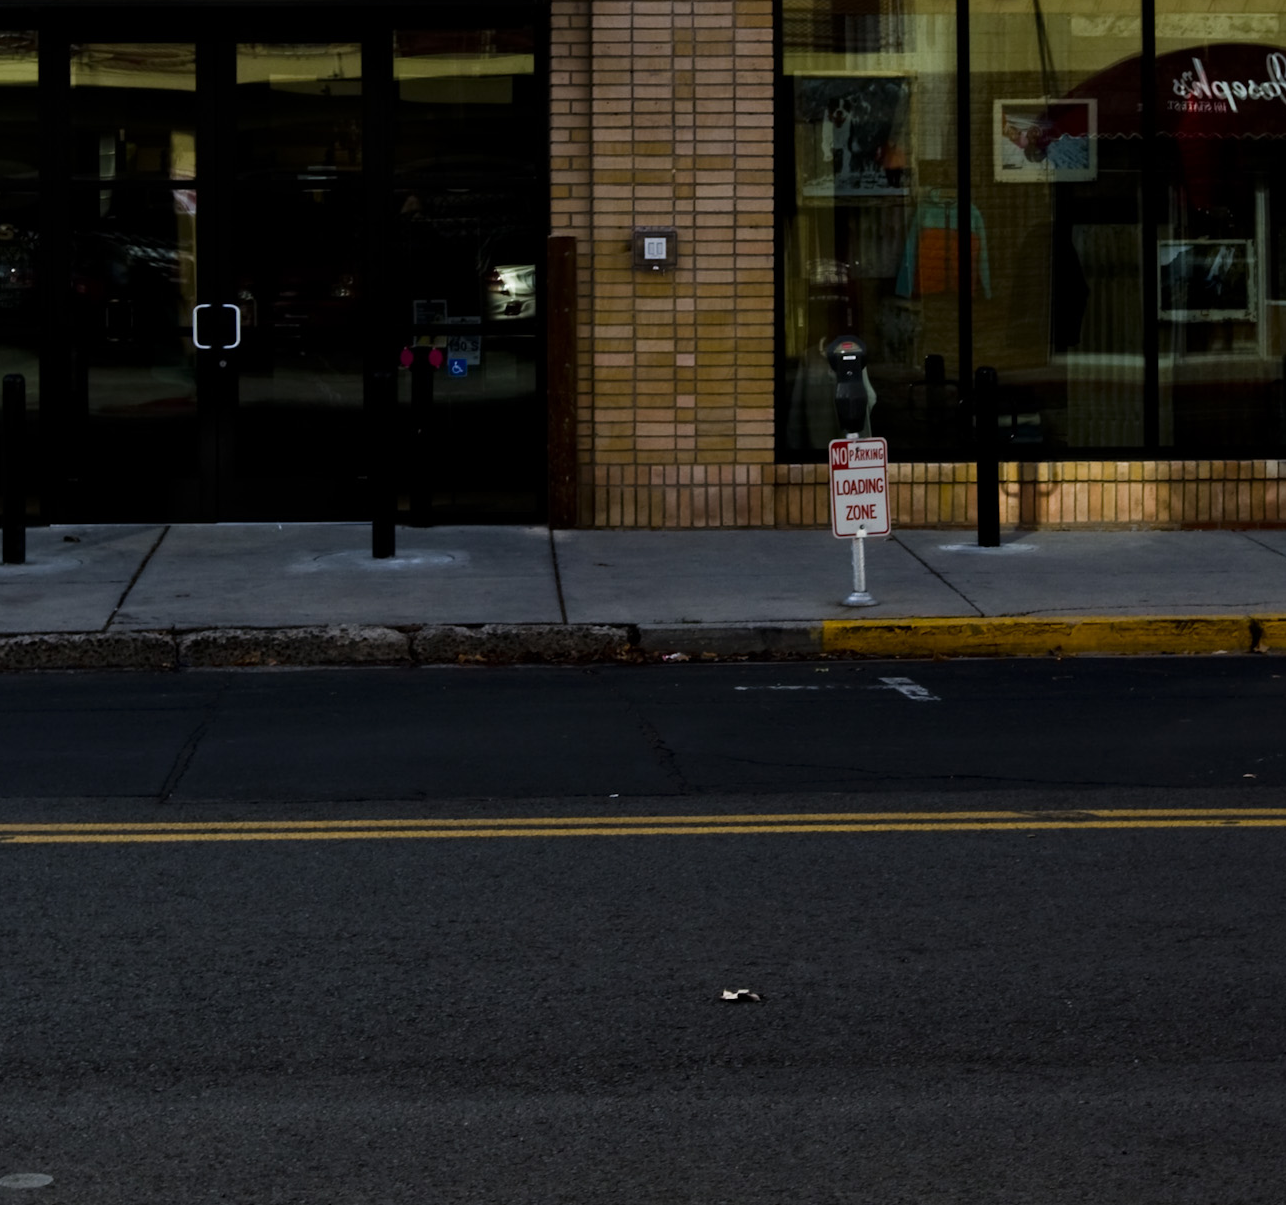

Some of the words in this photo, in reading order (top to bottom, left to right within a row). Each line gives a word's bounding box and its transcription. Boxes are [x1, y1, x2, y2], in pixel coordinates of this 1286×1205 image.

[832, 447, 848, 465] NO
[849, 448, 884, 462] PARKING
[836, 478, 884, 496] LOADING
[846, 504, 878, 521] ZONE
